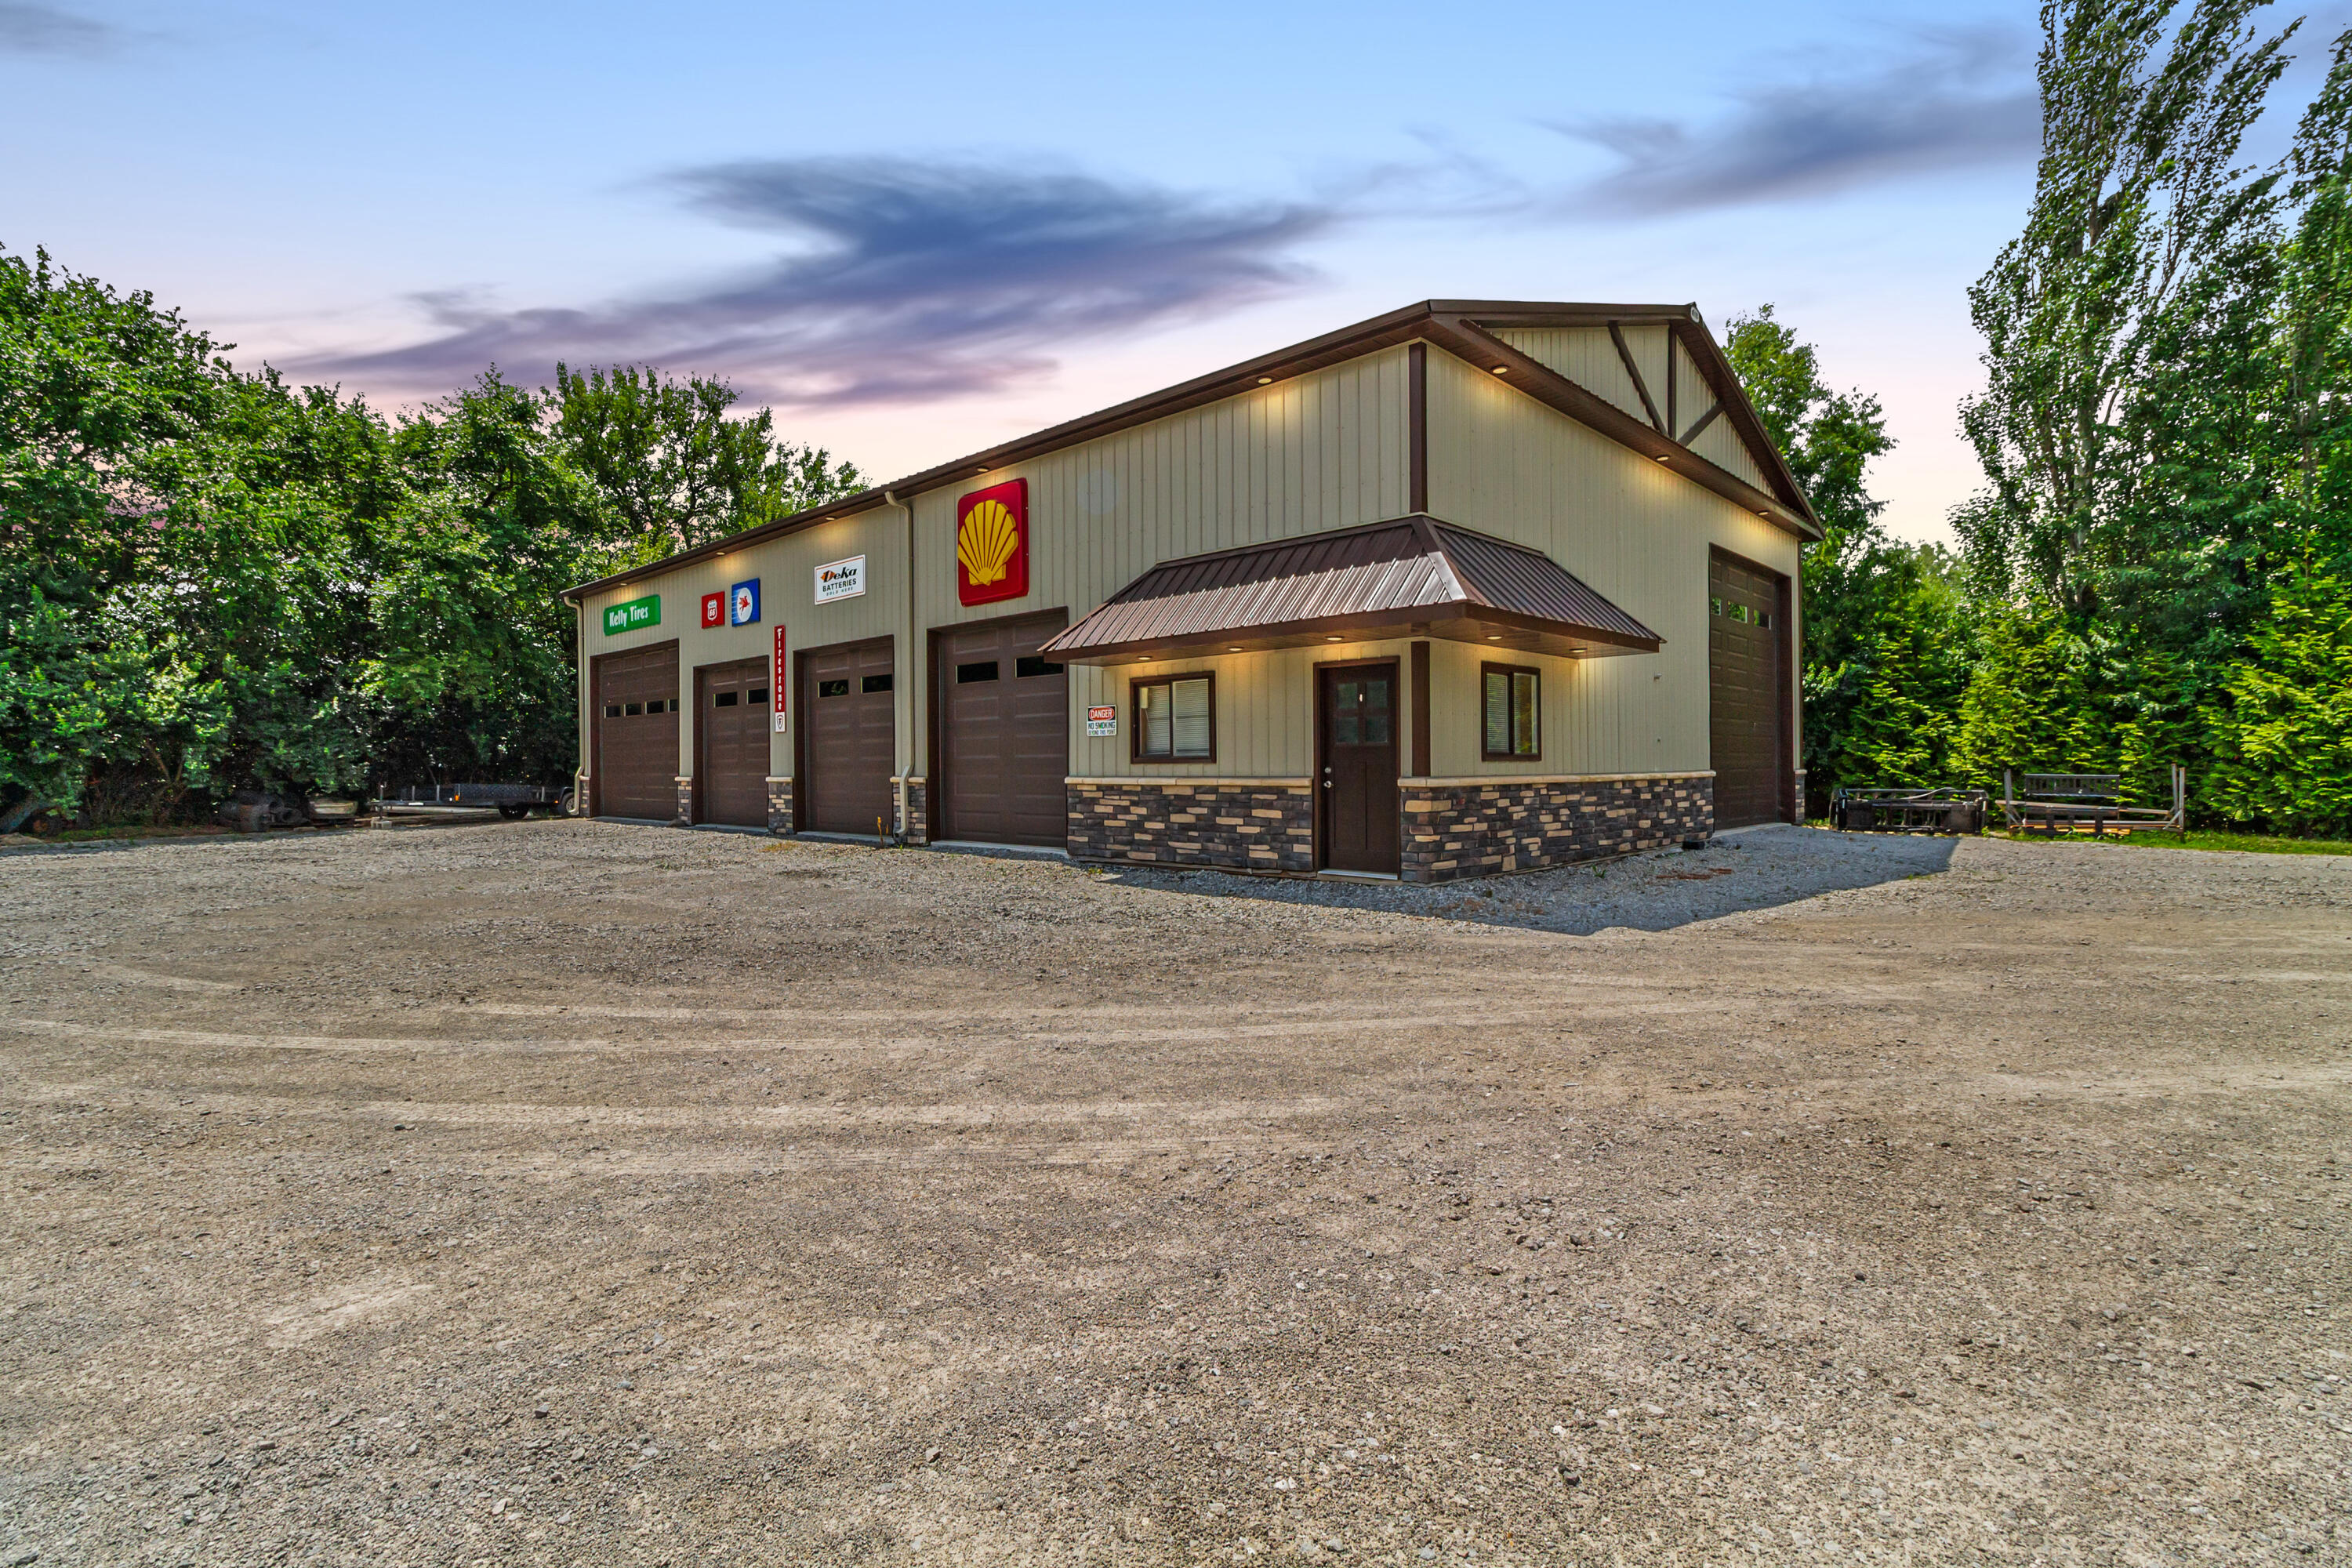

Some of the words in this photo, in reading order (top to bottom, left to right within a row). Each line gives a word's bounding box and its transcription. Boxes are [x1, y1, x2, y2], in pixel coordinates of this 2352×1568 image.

[822, 567, 857, 583] Deka
[823, 579, 856, 592] BATTERIES
[609, 609, 627, 627] Kelly
[630, 605, 648, 622] Tires
[1091, 710, 1112, 718] DANGER
